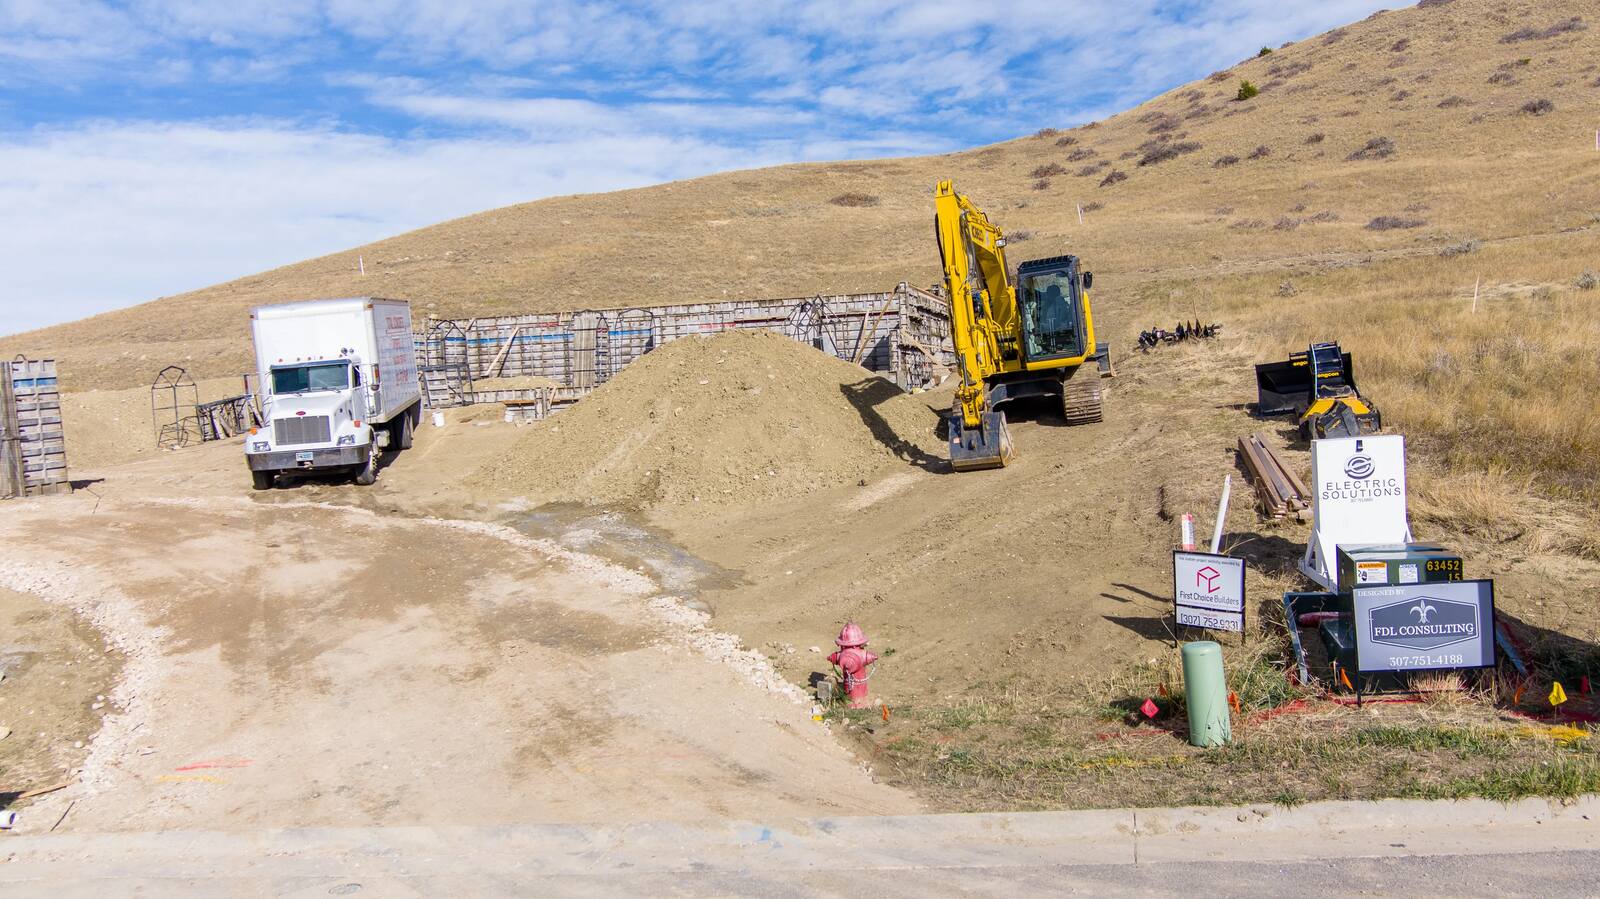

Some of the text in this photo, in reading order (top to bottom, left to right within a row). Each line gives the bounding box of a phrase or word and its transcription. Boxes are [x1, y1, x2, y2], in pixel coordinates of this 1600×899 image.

[1326, 478, 1396, 491] ELECTRIC
[1322, 487, 1401, 500] SOLUTIONS
[1426, 560, 1460, 571] 63452
[1448, 573, 1460, 581] 15
[1179, 591, 1192, 600] First
[1193, 592, 1214, 602] Choice
[1213, 595, 1240, 606] Builders
[1358, 588, 1404, 597] DESIGNED BY
[1203, 616, 1239, 630] 752.9331
[1374, 623, 1474, 637] FDL CONSULTING
[1390, 653, 1463, 667] 307-751-4188
